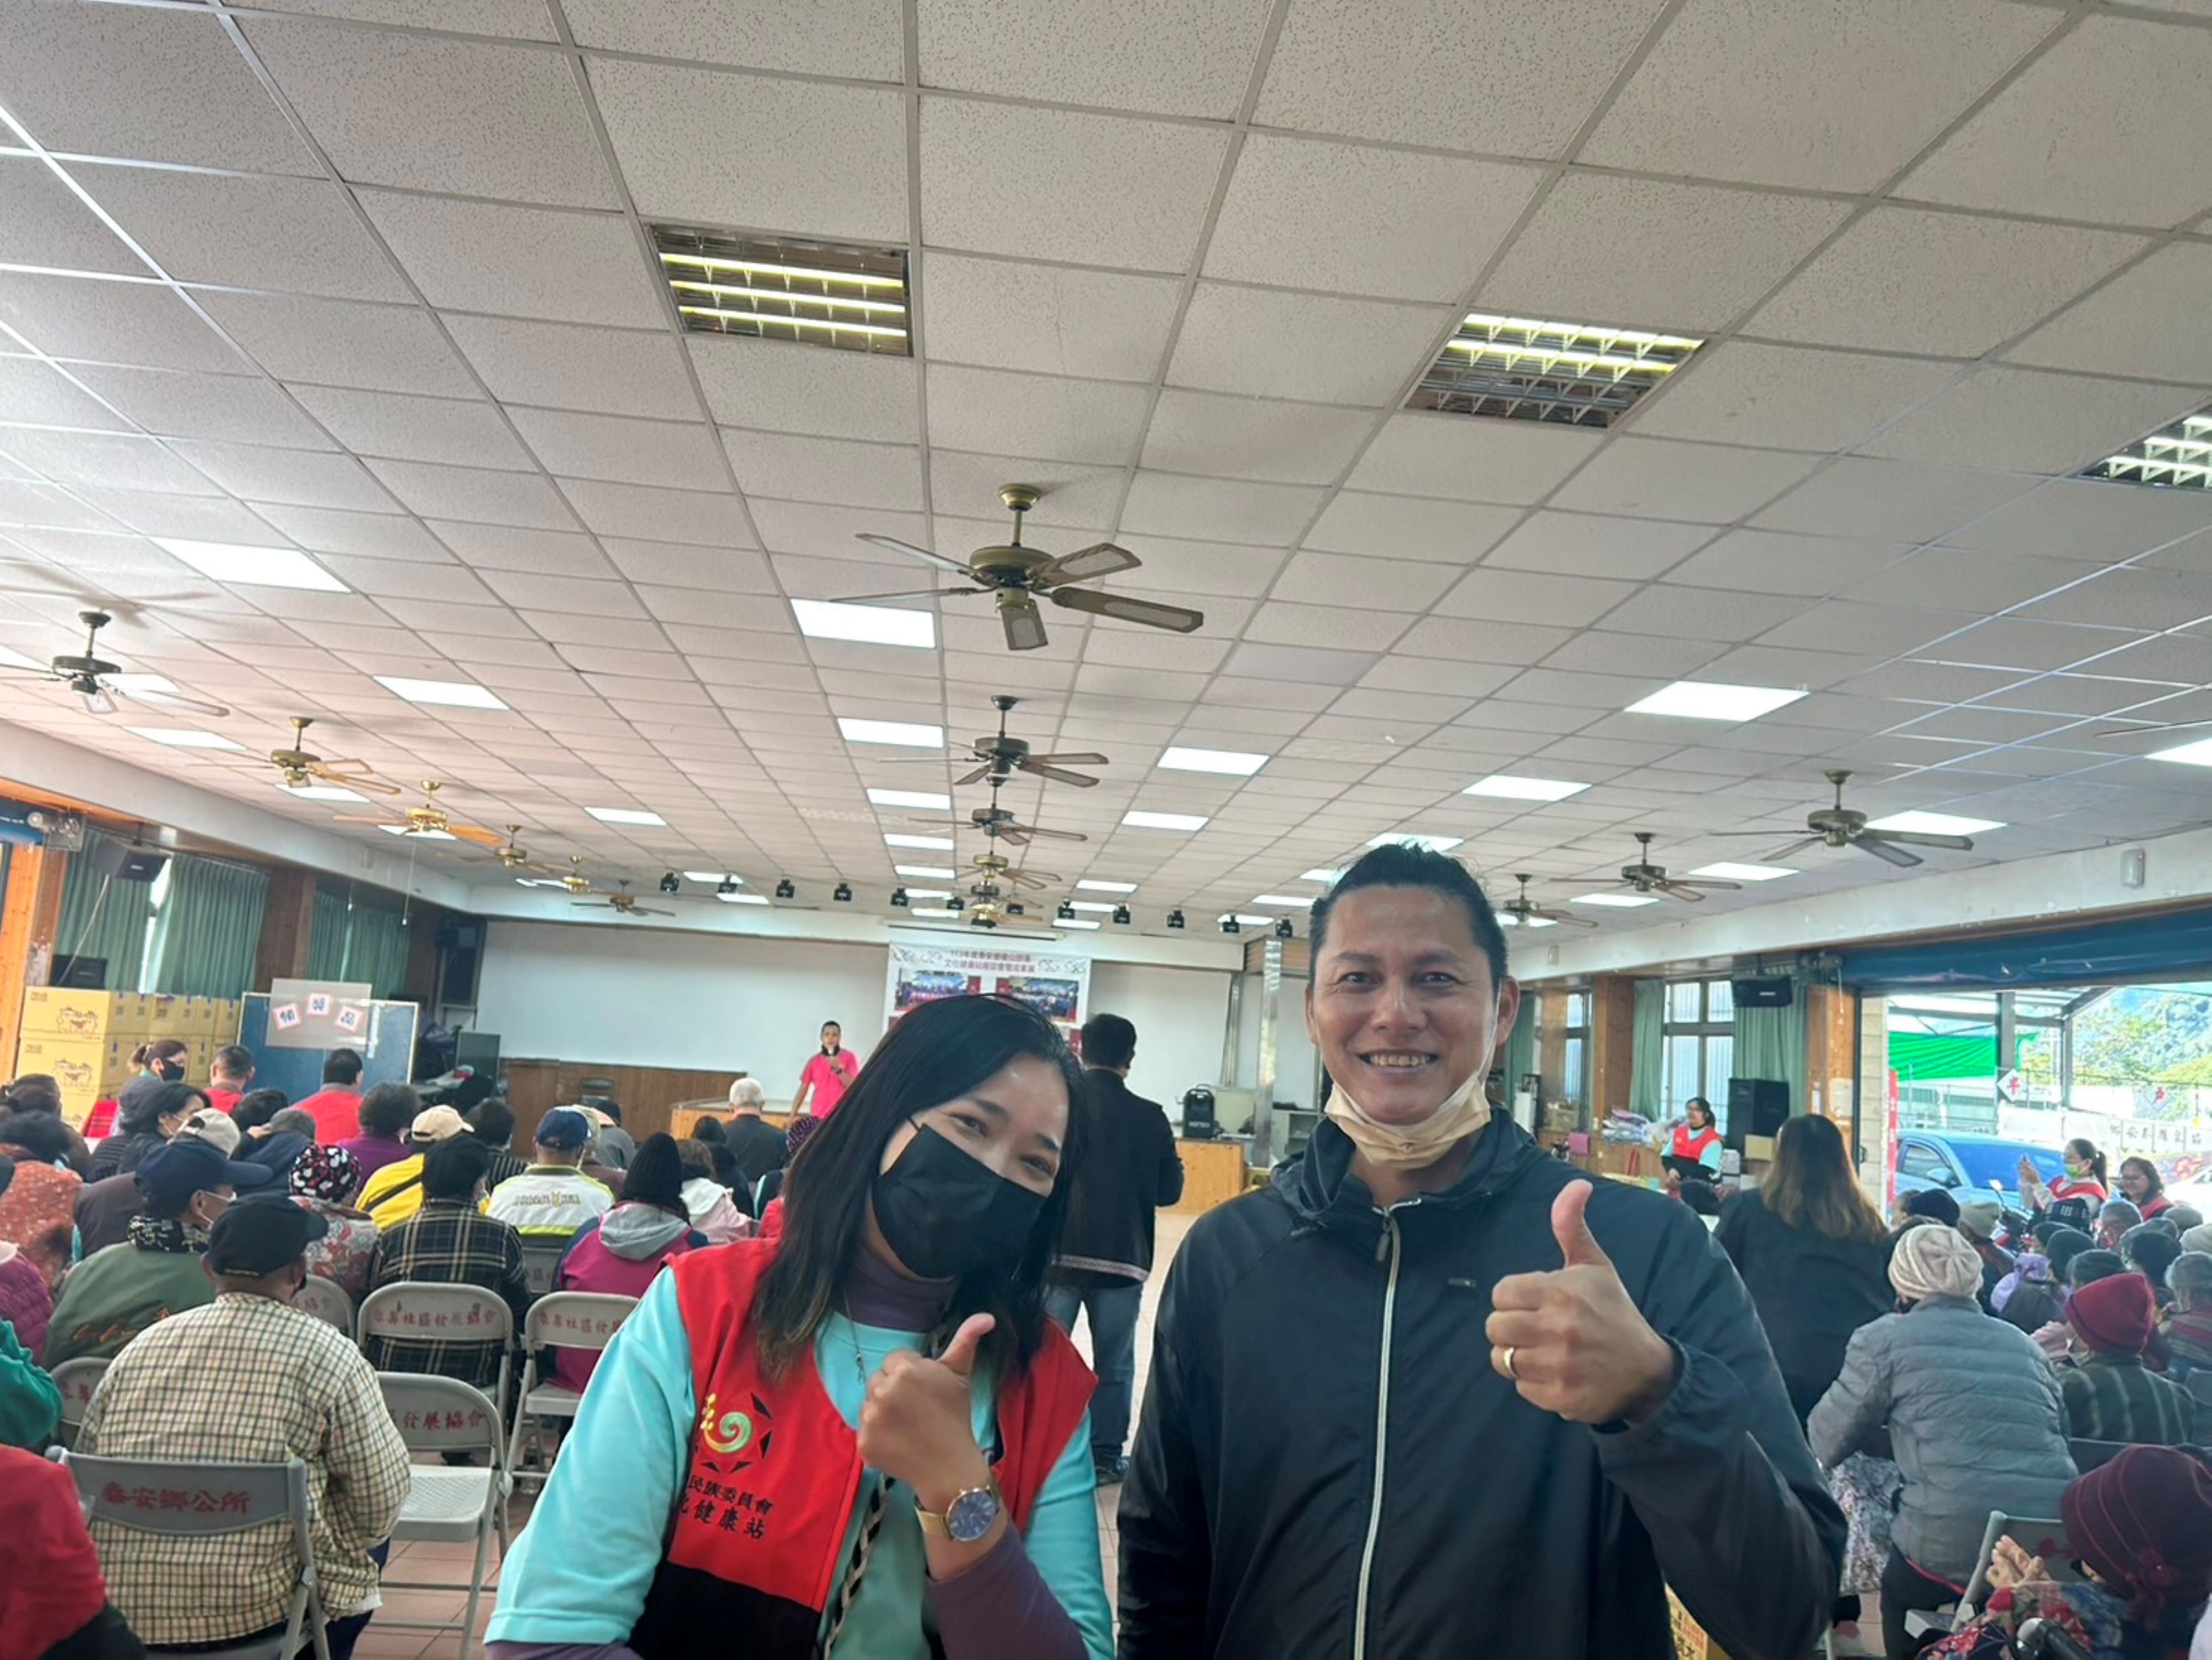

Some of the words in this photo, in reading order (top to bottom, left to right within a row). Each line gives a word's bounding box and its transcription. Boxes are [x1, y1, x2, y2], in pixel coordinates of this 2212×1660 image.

[102, 1481, 251, 1515] 泰安鄉公所
[688, 1474, 773, 1515] 民族委員會
